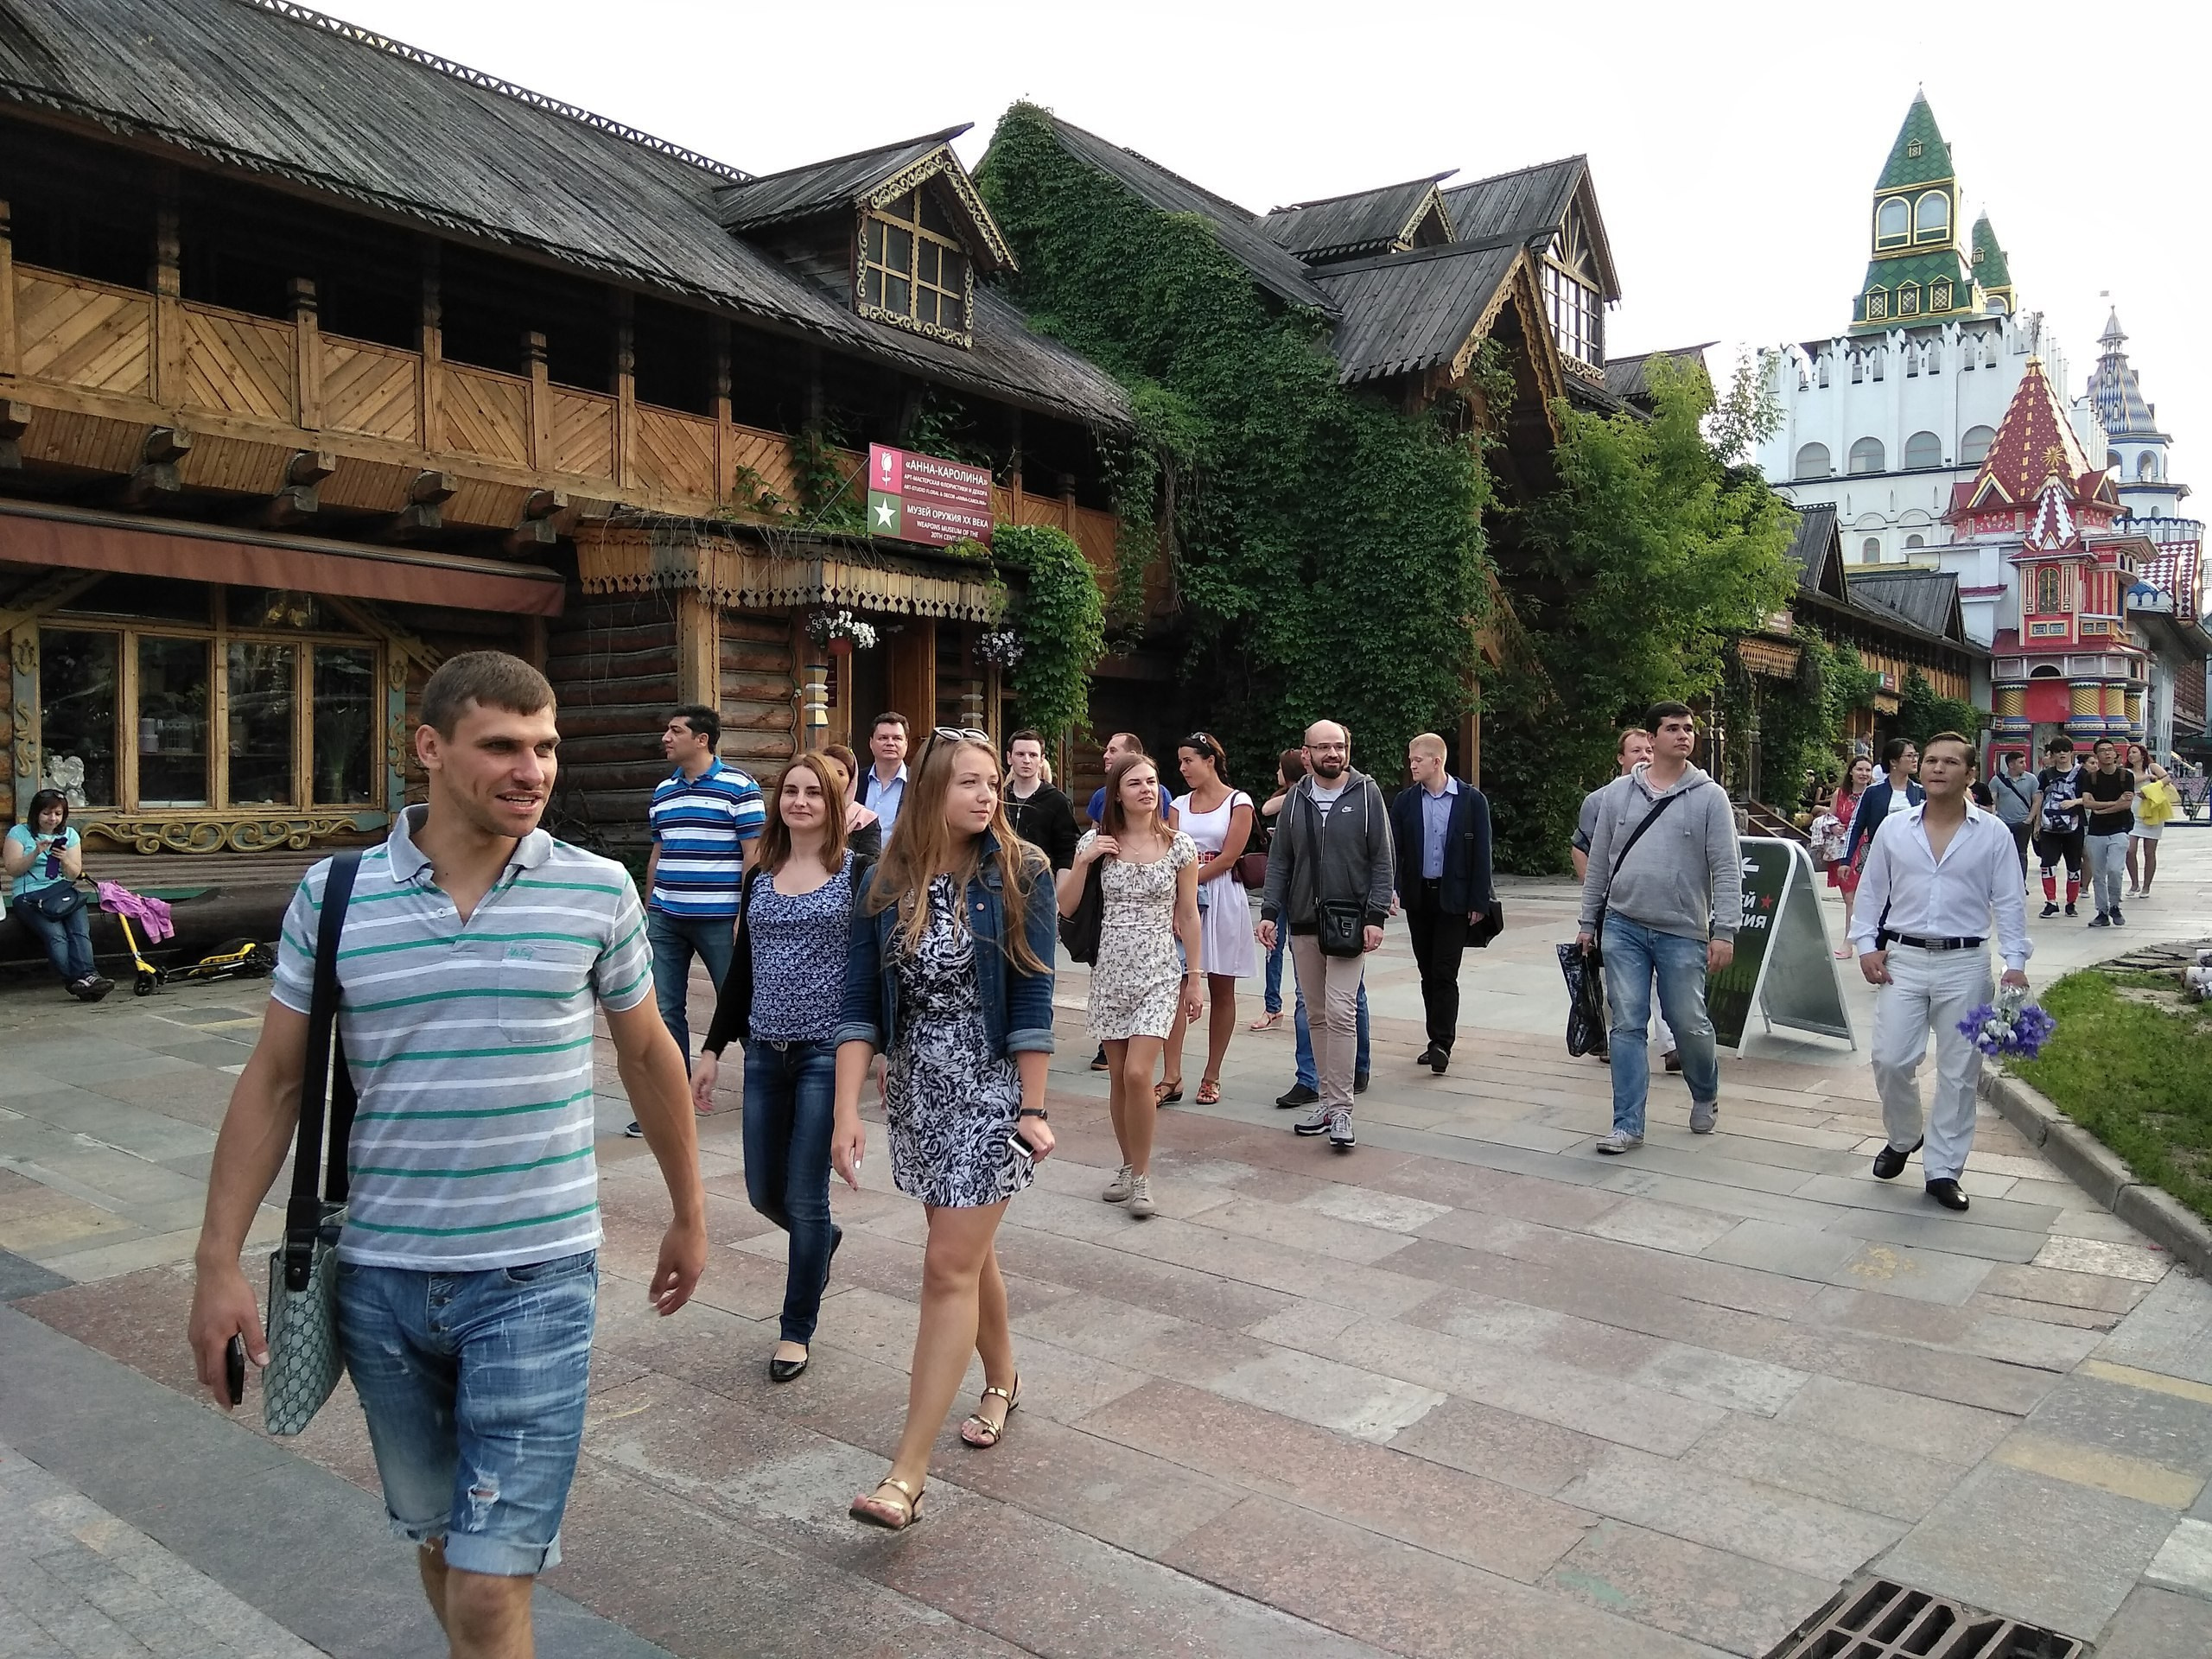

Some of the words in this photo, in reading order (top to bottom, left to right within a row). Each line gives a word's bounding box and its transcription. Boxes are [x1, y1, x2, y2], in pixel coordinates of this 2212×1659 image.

[906, 460, 988, 485] «АННА-КАРОЛИНА»
[904, 474, 940, 486] АРТ-МАСТЕРСКАЯ
[940, 481, 968, 492] ФЛОРИСТИКИ
[972, 488, 988, 497] ДЕКОРА
[904, 484, 926, 493] ART-STUDIO
[907, 505, 931, 517] МУЗЕЙ
[932, 511, 961, 523] ОРУЖИЯ
[973, 518, 988, 528] ВЕКА
[917, 520, 940, 531] WEAPONS
